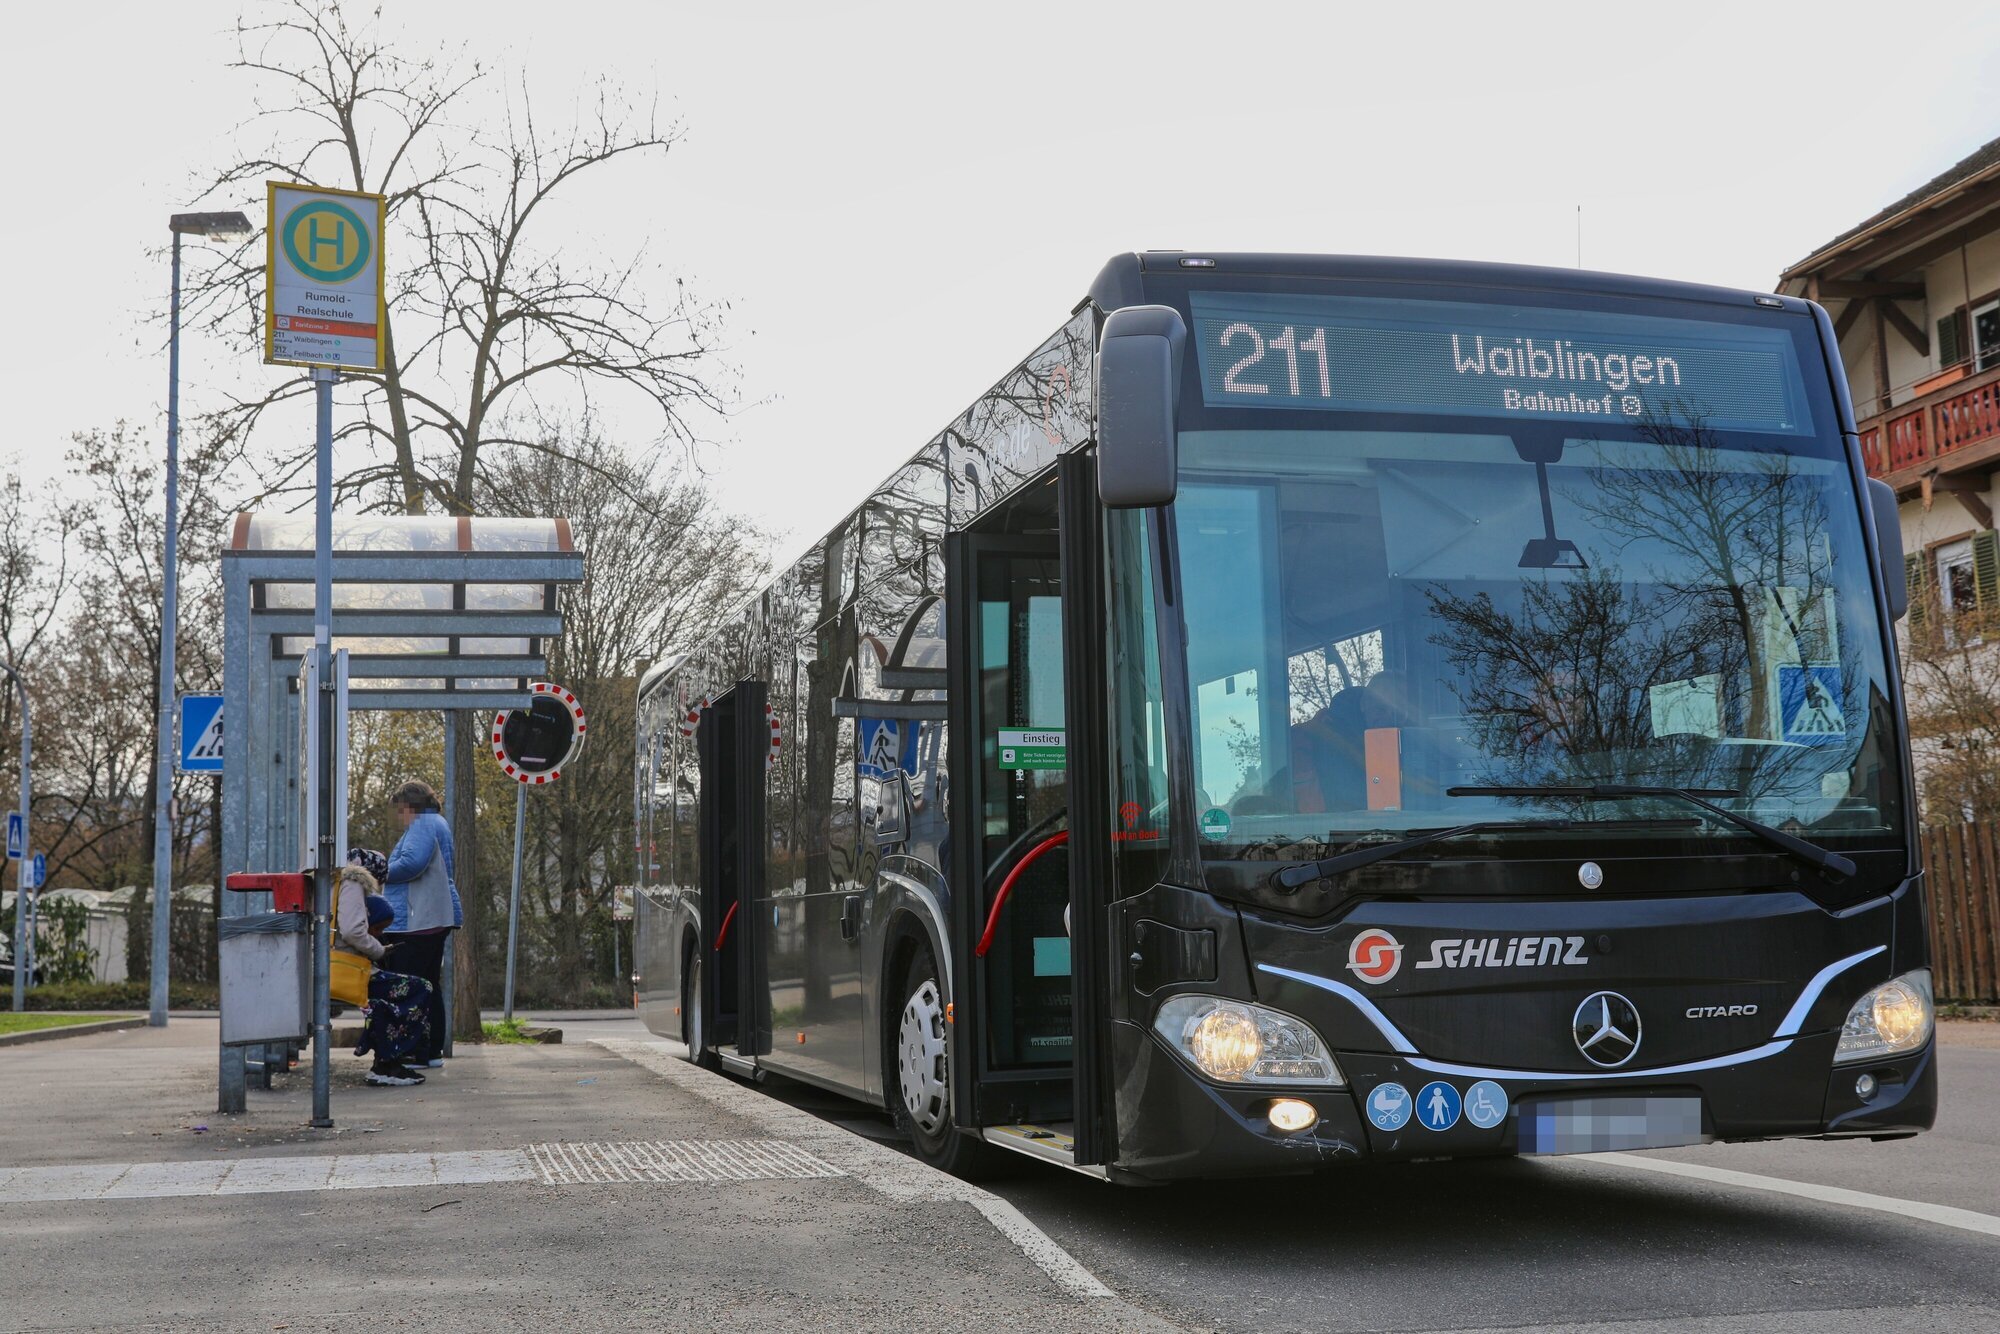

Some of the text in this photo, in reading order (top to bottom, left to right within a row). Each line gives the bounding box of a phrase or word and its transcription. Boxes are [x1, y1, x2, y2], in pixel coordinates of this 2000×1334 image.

[305, 291, 345, 304] Rumold
[297, 305, 354, 319] Realschule
[293, 336, 332, 346] Waiblingen
[293, 350, 323, 359] Fellbach
[1220, 322, 1331, 398] 211
[1451, 334, 1681, 391] Waiblingen
[1503, 388, 1612, 415] Bahnhof
[1022, 733, 1060, 746] Einstieg
[1685, 1004, 1758, 1019] CITARO
